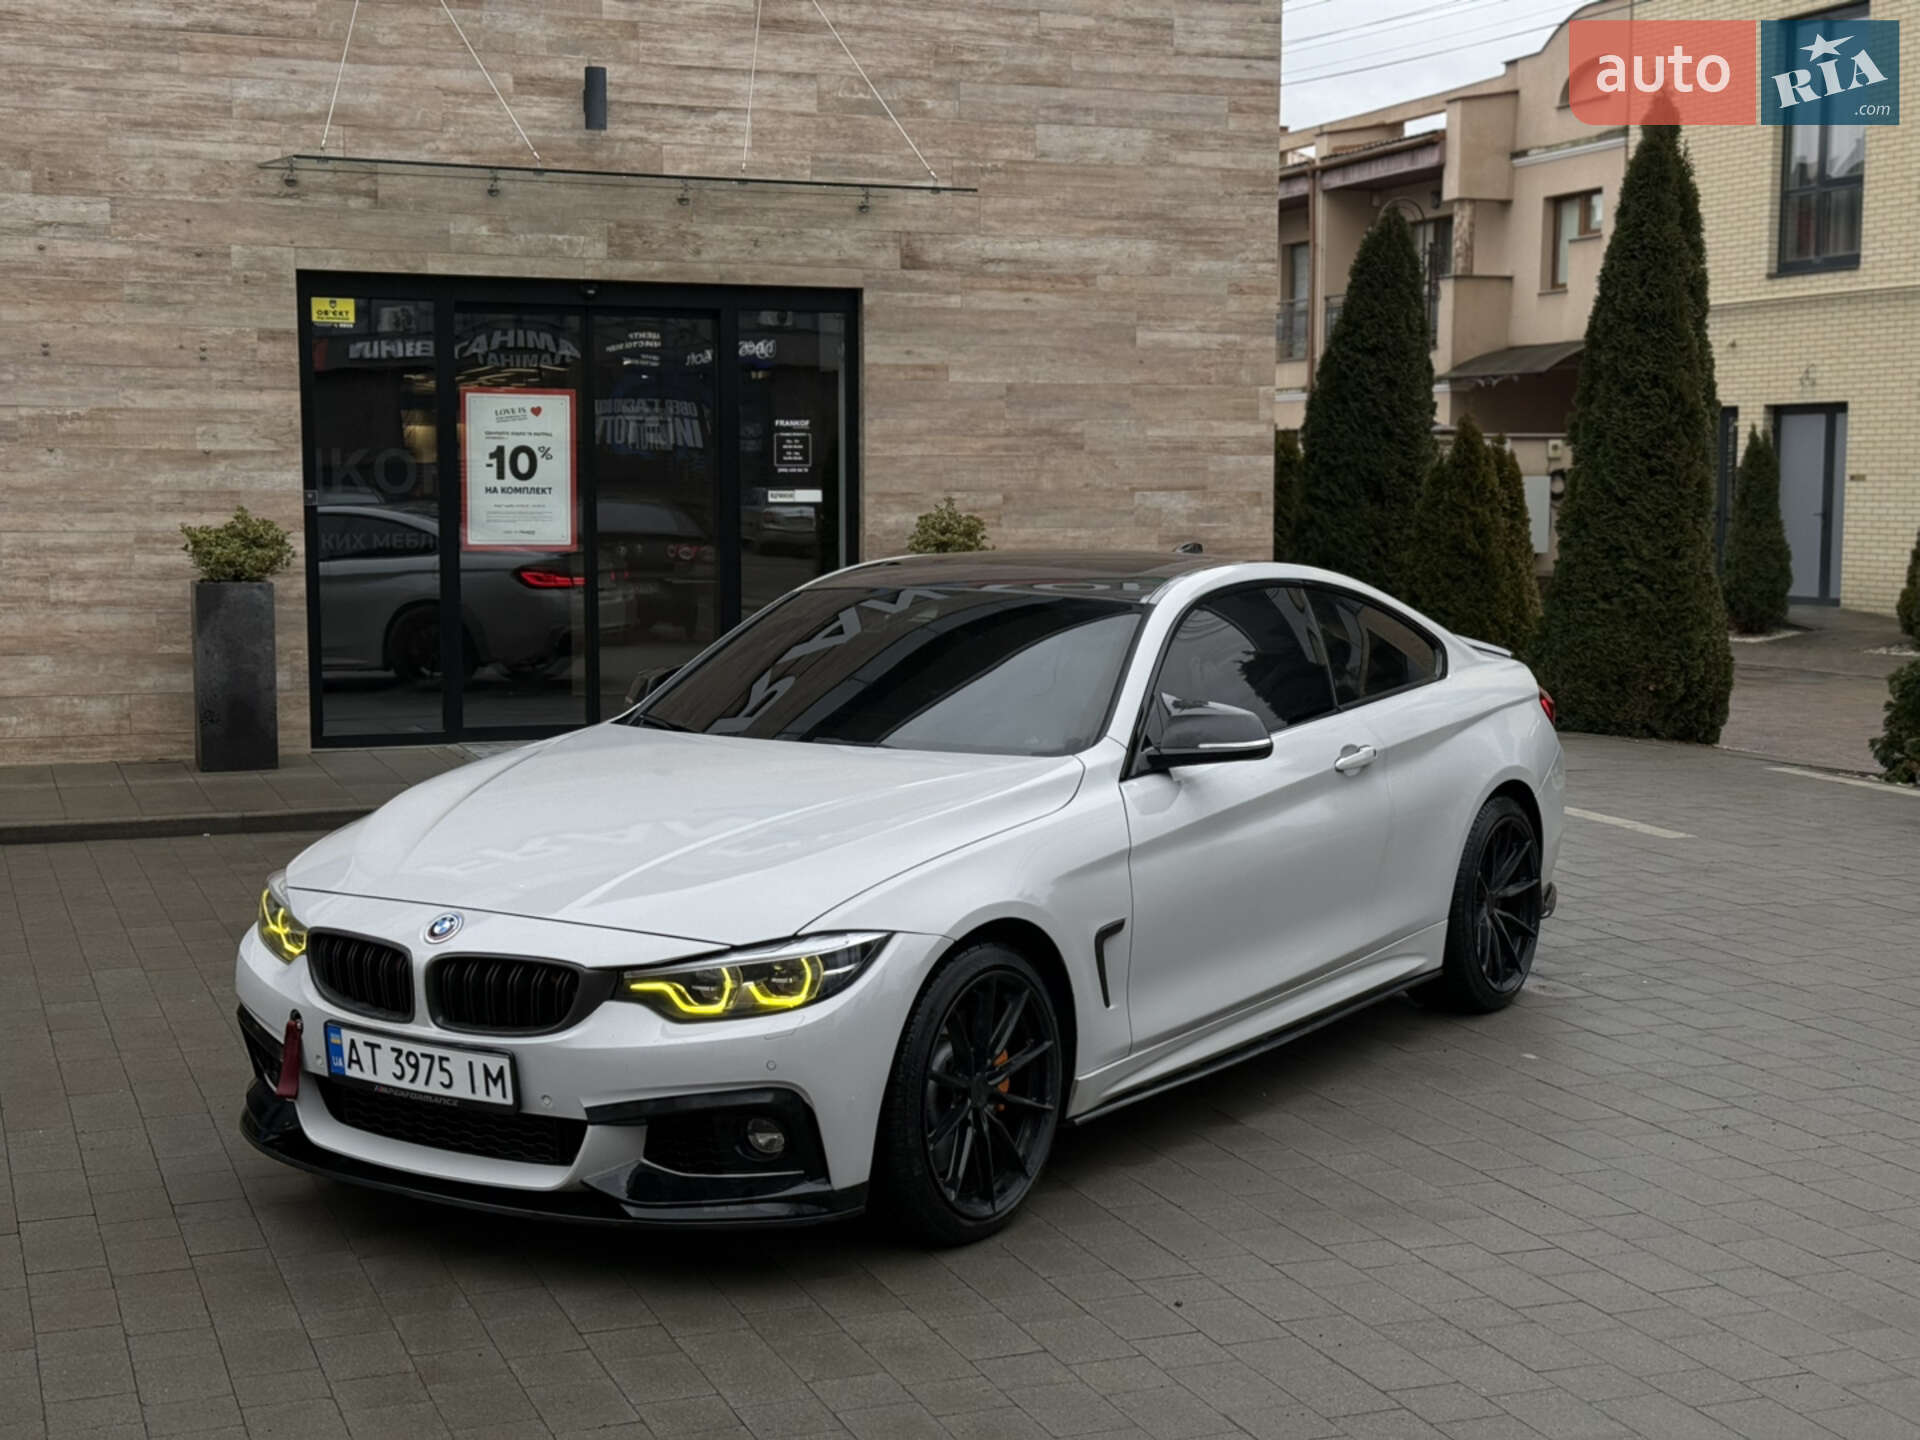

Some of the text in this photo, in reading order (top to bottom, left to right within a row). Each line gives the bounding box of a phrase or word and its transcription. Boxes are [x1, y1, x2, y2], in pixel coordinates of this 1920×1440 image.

[494, 407, 516, 417] LOVE
[485, 444, 553, 482] -10%
[484, 486, 553, 495] НА КОМПЛЕКТ
[331, 1055, 345, 1067] UA
[347, 1037, 508, 1100] AT 3975 IM
